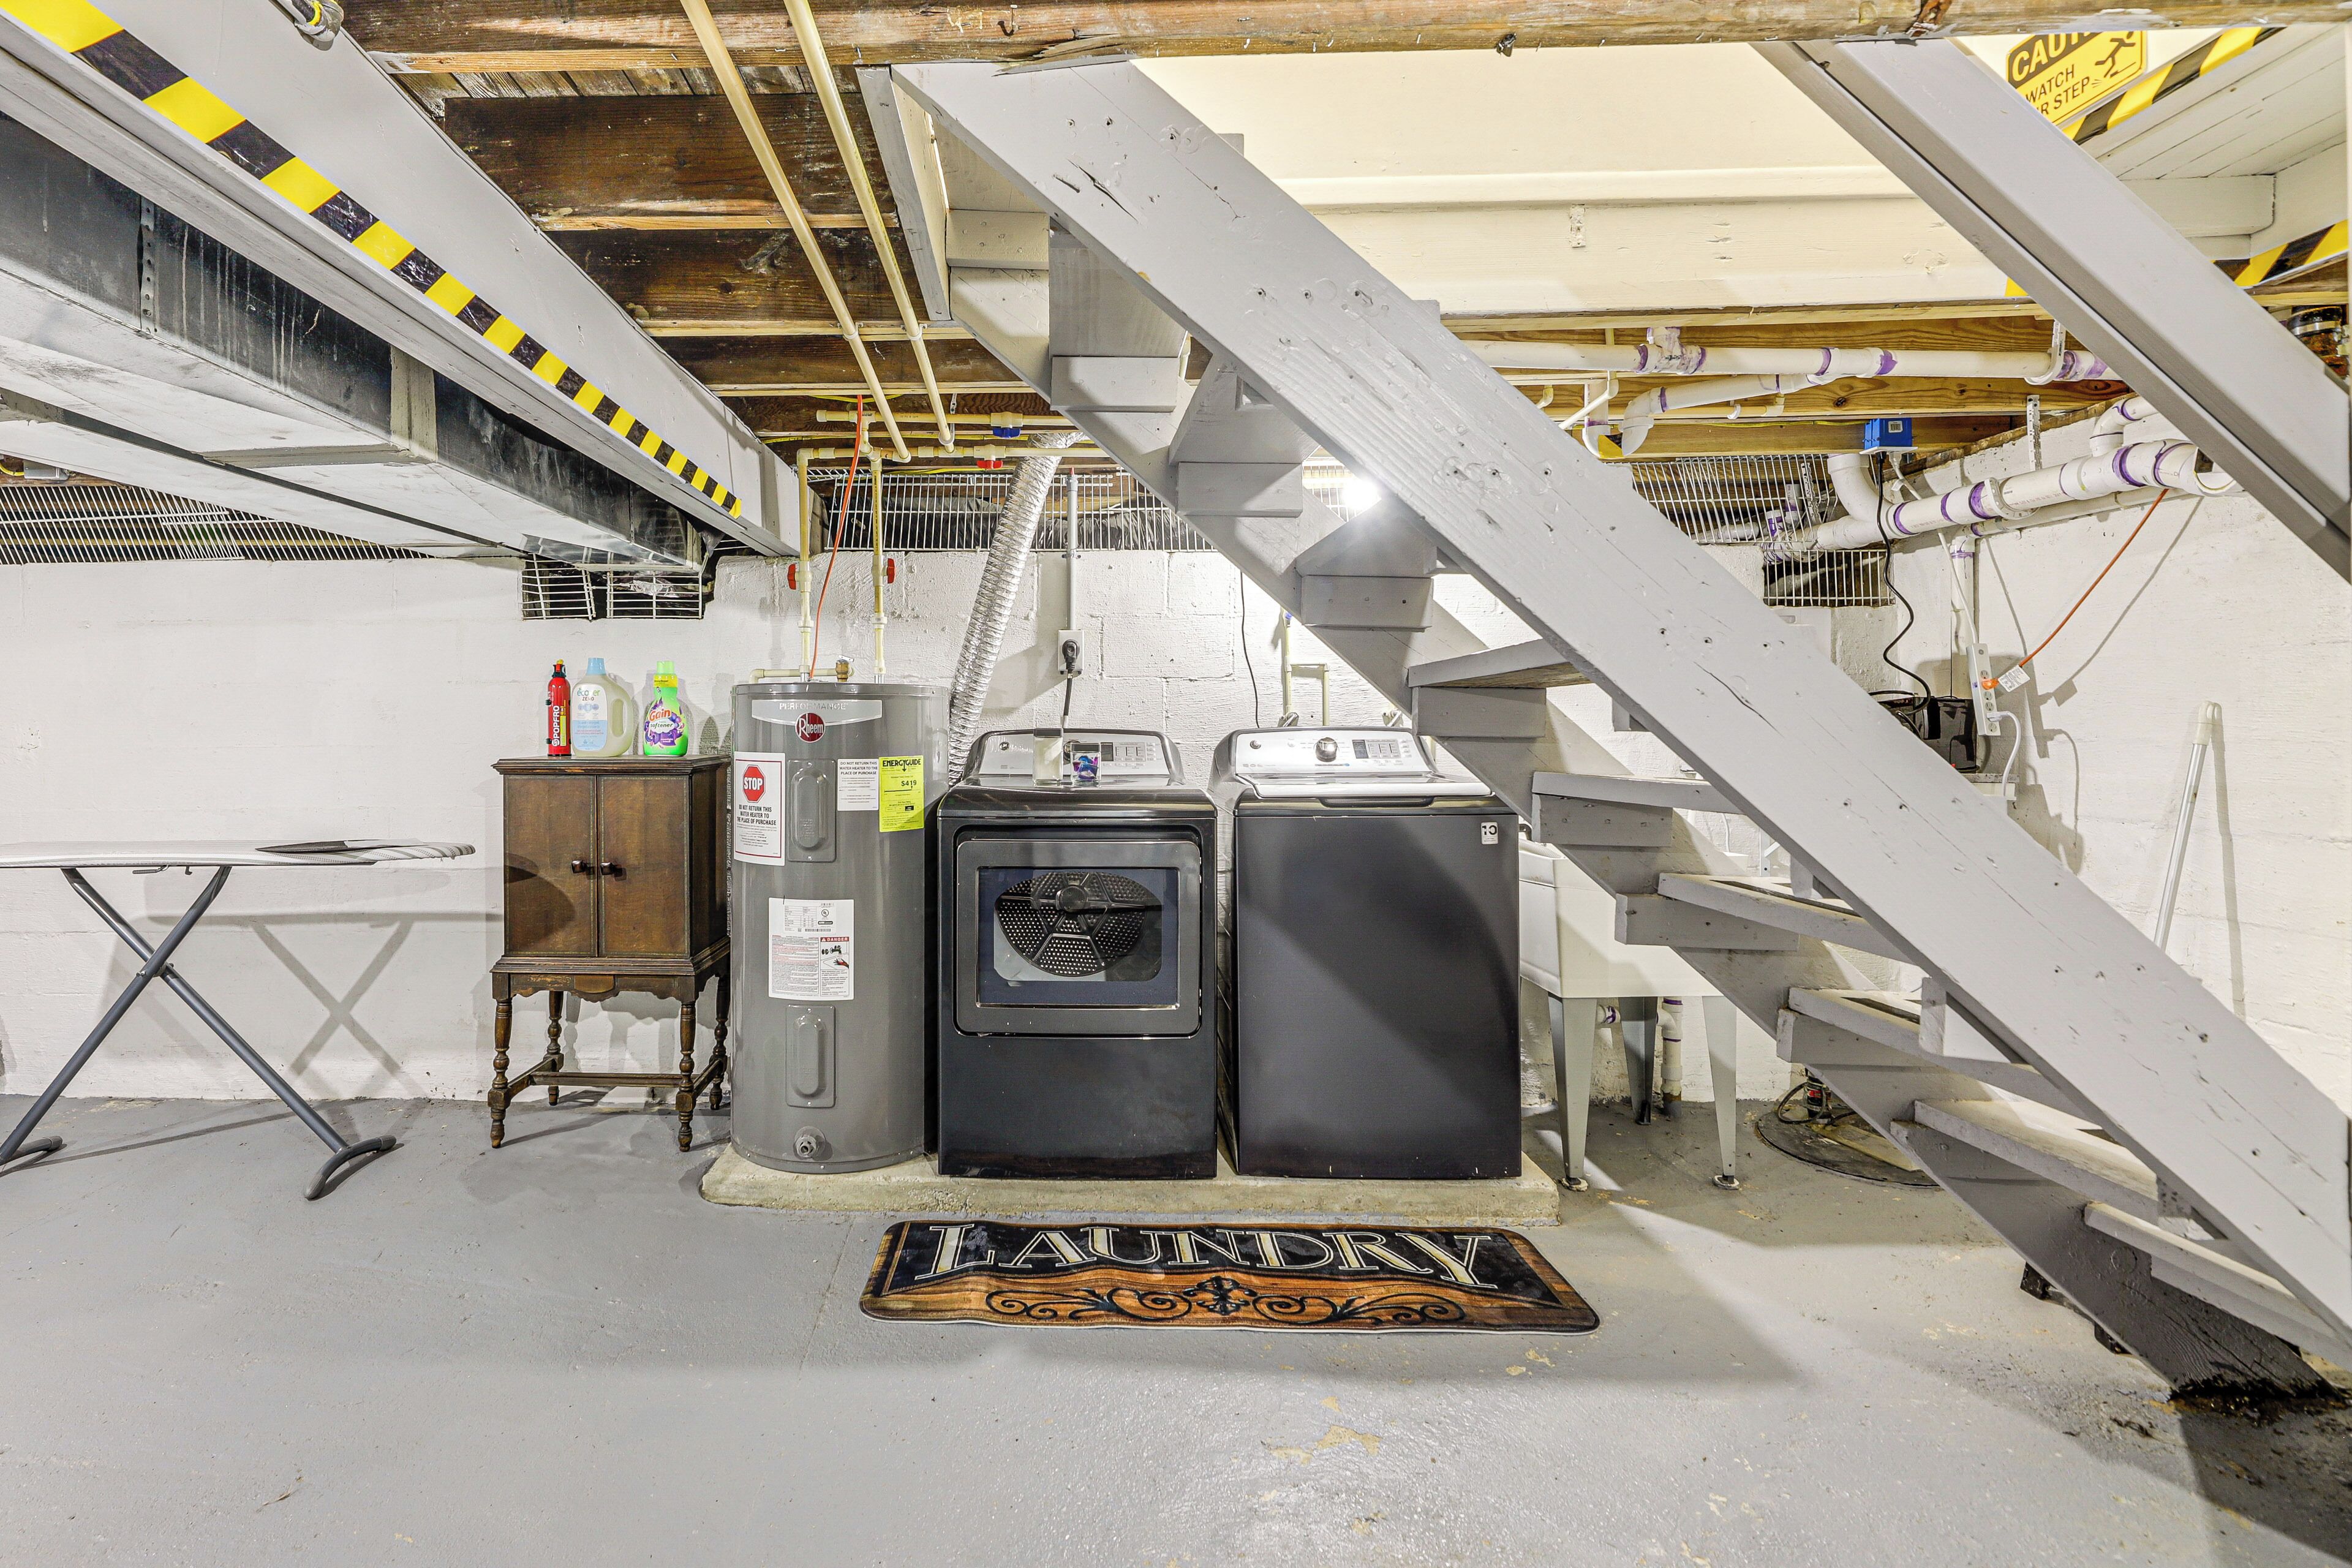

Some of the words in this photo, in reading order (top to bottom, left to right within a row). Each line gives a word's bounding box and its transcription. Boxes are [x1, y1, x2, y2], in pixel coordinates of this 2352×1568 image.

[2026, 64, 2075, 103] WATCH
[2054, 76, 2090, 109] STEP
[649, 709, 671, 722] Gain
[799, 714, 823, 737] Rheem
[744, 777, 763, 790] STOP
[1482, 825, 1498, 835] 10
[914, 1223, 1499, 1289] LAUNDRY
